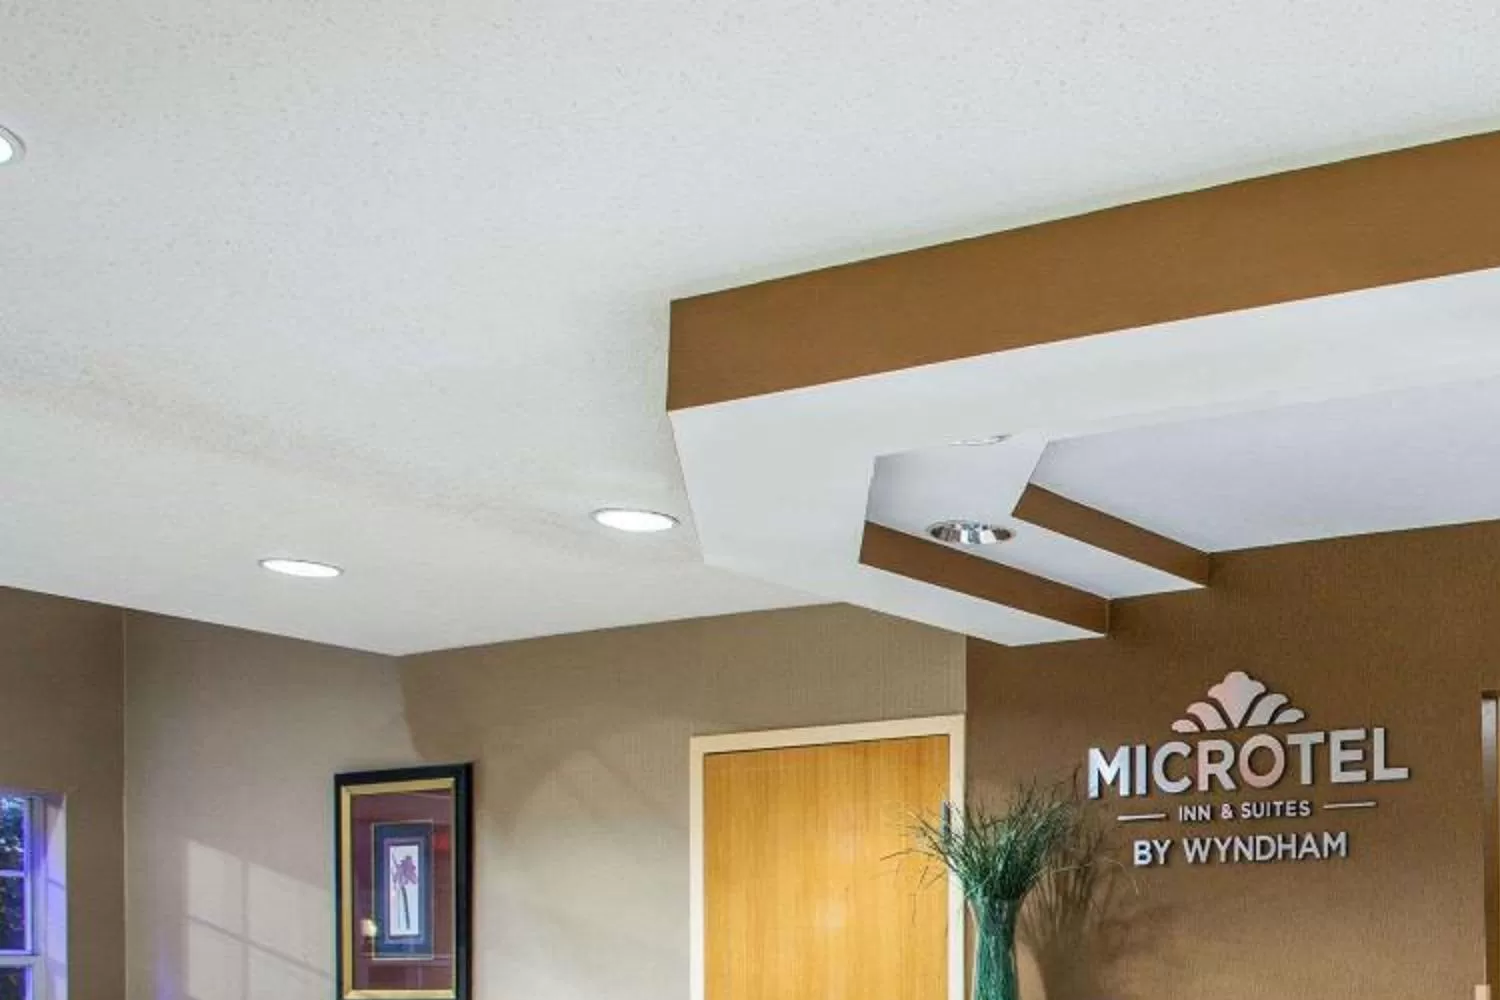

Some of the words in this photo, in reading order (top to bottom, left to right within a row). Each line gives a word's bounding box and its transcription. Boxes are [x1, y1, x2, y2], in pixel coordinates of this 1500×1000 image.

[1088, 727, 1409, 798] MICROTEL
[1178, 804, 1212, 823] INN
[1221, 803, 1238, 821] &
[1240, 800, 1312, 820] SUITES
[1132, 838, 1172, 867] BY
[1183, 831, 1349, 864] WYNDHAM
